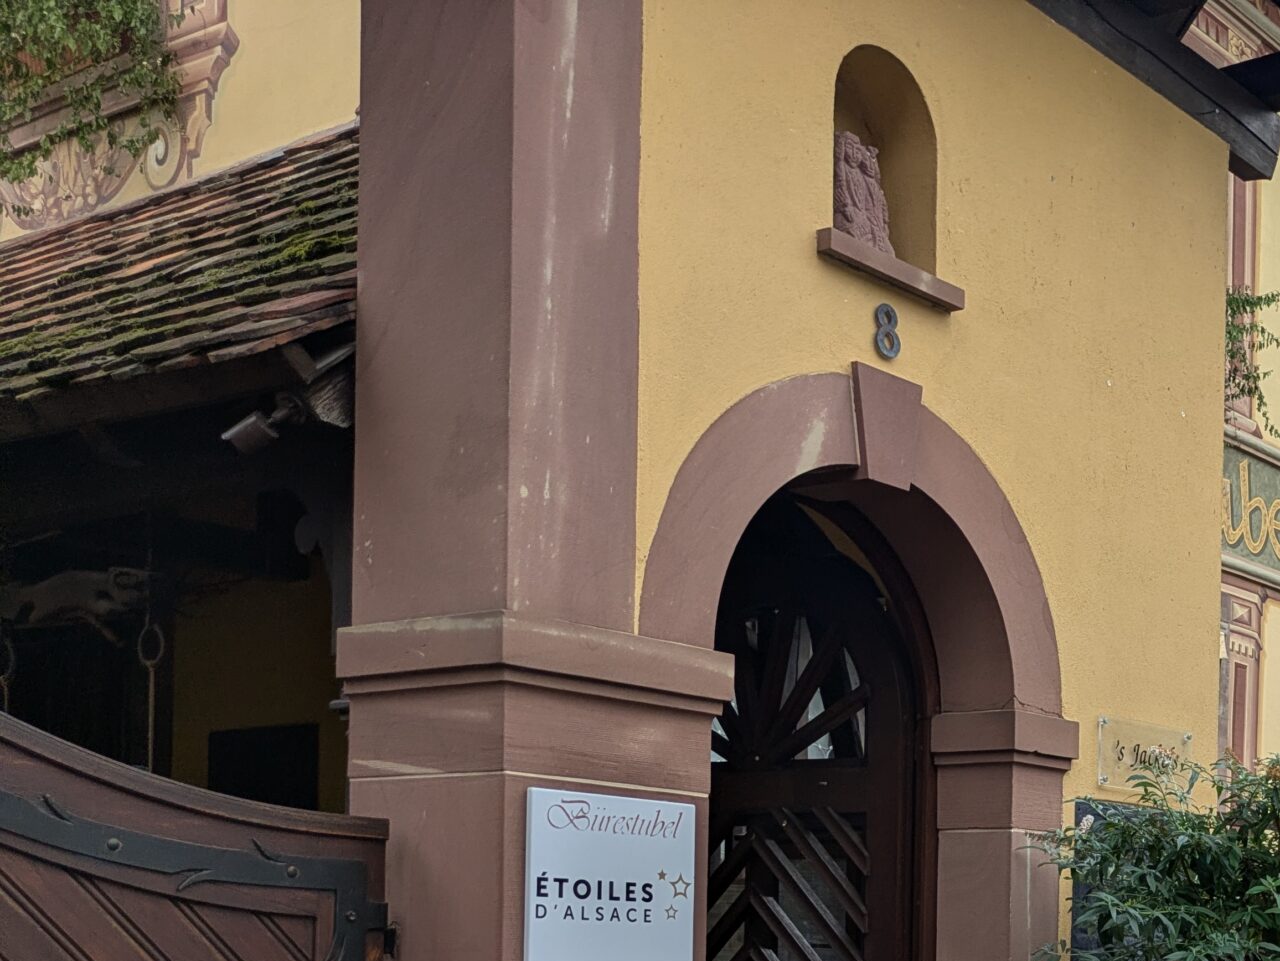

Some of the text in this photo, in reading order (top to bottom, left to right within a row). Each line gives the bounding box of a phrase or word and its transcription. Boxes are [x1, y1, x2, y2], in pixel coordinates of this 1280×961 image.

[874, 303, 901, 359] 8
[547, 798, 683, 839] Bürestubel
[536, 871, 654, 903] ÉTOILES
[535, 904, 652, 923] D'ALSACE
